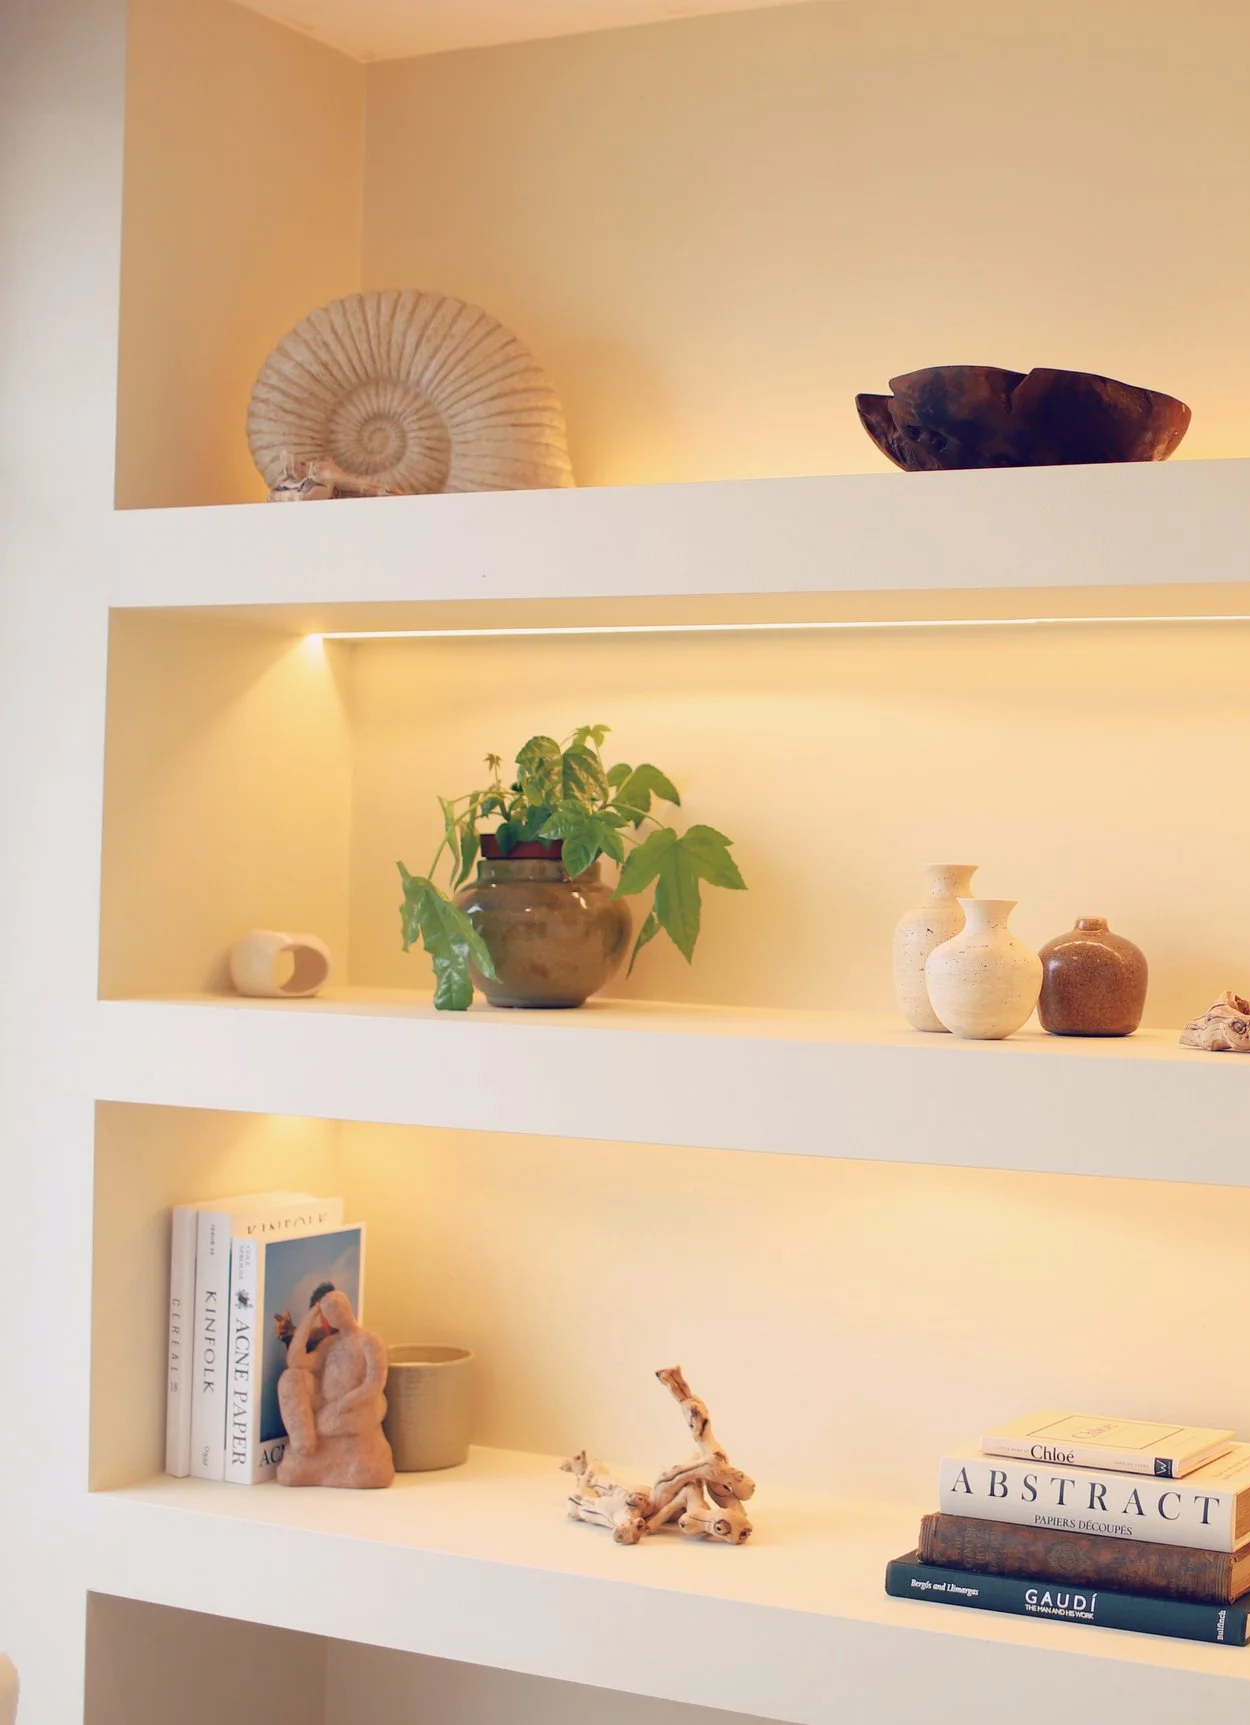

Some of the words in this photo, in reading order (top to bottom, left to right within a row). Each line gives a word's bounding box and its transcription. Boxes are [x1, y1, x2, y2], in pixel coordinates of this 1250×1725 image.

[171, 1297, 180, 1372] CEREAL
[202, 1290, 217, 1393] KINFOLK
[234, 1318, 251, 1382] ACNE
[231, 1389, 248, 1465] PAPER
[1030, 1444, 1075, 1464] Chloé
[950, 1465, 1221, 1526] ABSTRACT
[1033, 1513, 1075, 1529] PAPIERS
[1076, 1517, 1134, 1537] DÉCOUPÉS
[910, 1578, 932, 1590] Bergós
[932, 1581, 946, 1591] and
[1024, 1588, 1099, 1613] GAUDÍ
[1024, 1603, 1037, 1611] THE
[1037, 1605, 1052, 1613] MAN
[1052, 1607, 1065, 1616] AND
[1065, 1609, 1075, 1617] HIS
[1075, 1611, 1094, 1620] WORK
[1217, 1609, 1227, 1641] Bulfinch
